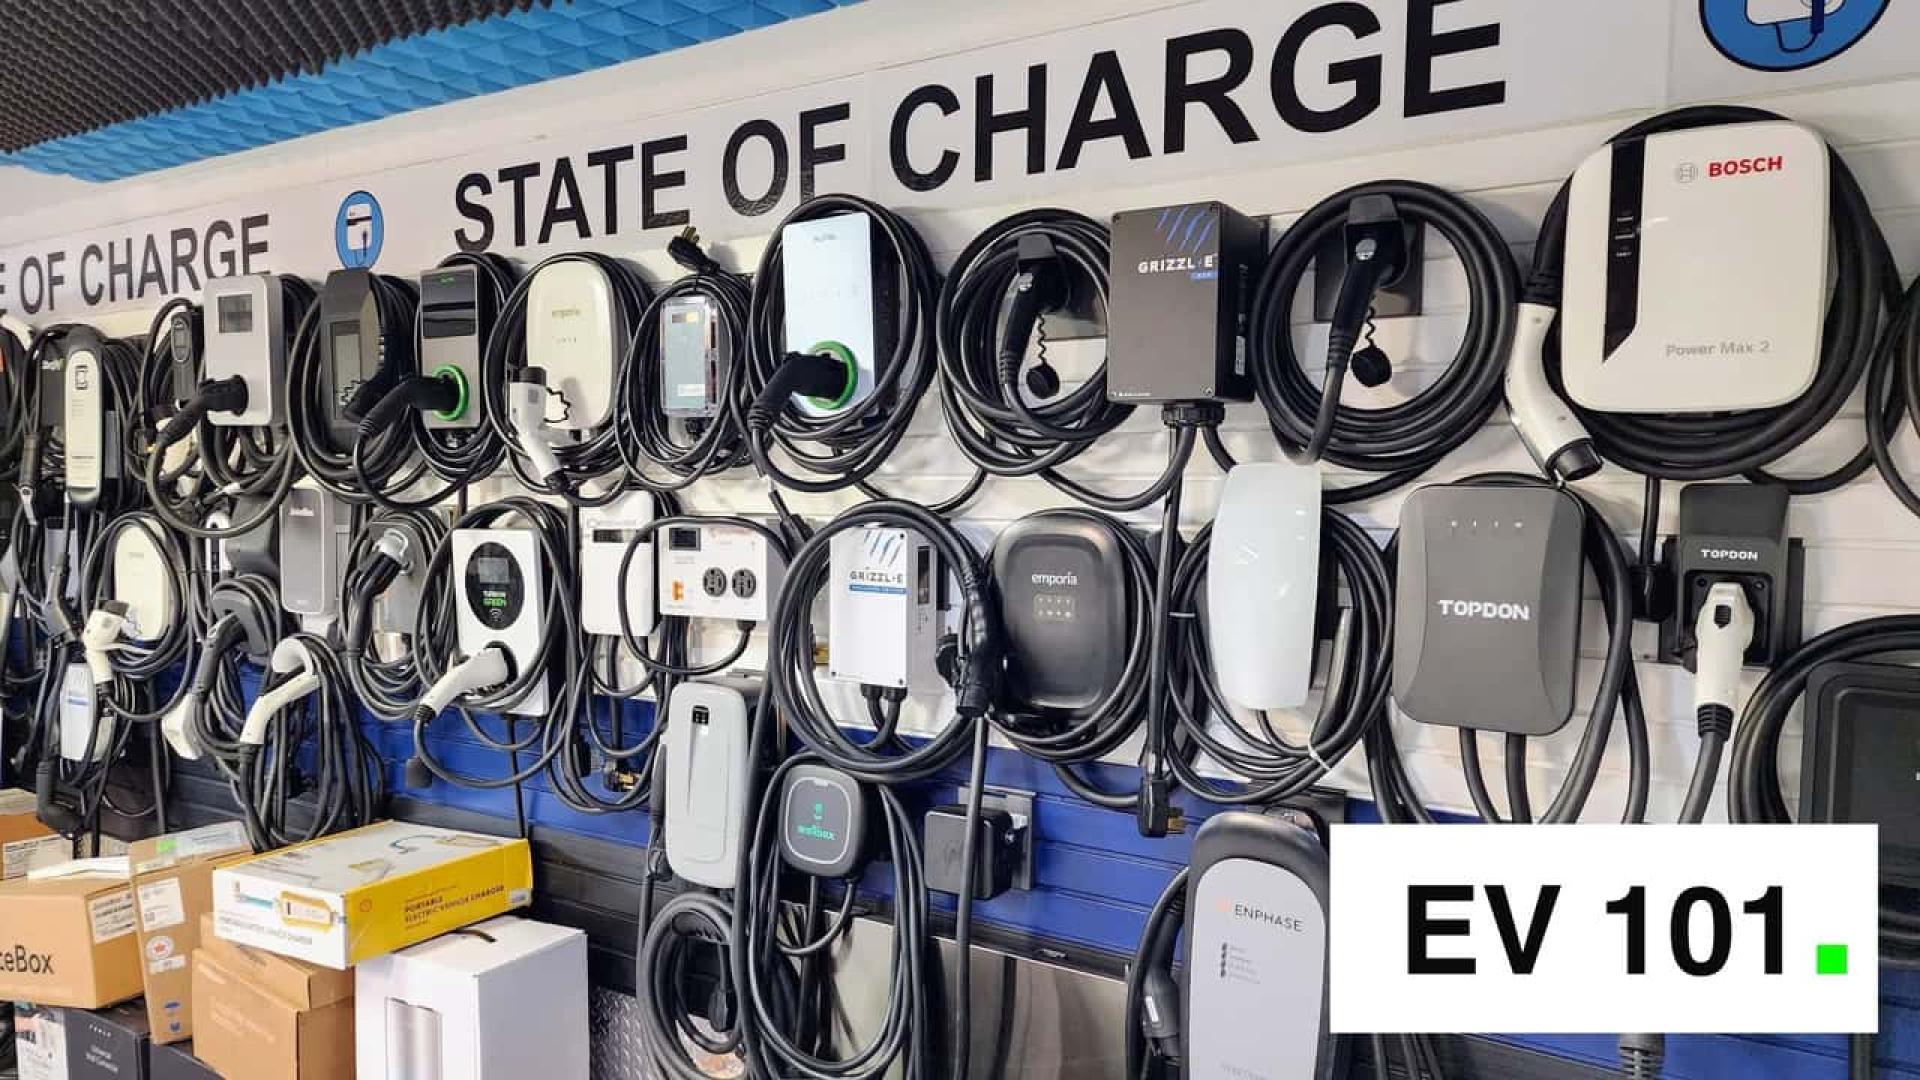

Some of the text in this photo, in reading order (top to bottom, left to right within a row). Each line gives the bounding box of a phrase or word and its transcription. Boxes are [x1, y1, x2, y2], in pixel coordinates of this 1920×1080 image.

[454, 0, 1507, 255] STATE OF CHARGE
[1709, 156, 1783, 178] BOSCH
[21, 251, 65, 315] OF
[80, 213, 270, 306] CHARGE
[1665, 339, 1770, 357] Power Max 2
[1700, 548, 1758, 561] TOPDON
[1031, 571, 1078, 587] emporia
[1437, 599, 1530, 621] TOPDON
[1234, 903, 1303, 932] ENPHASE
